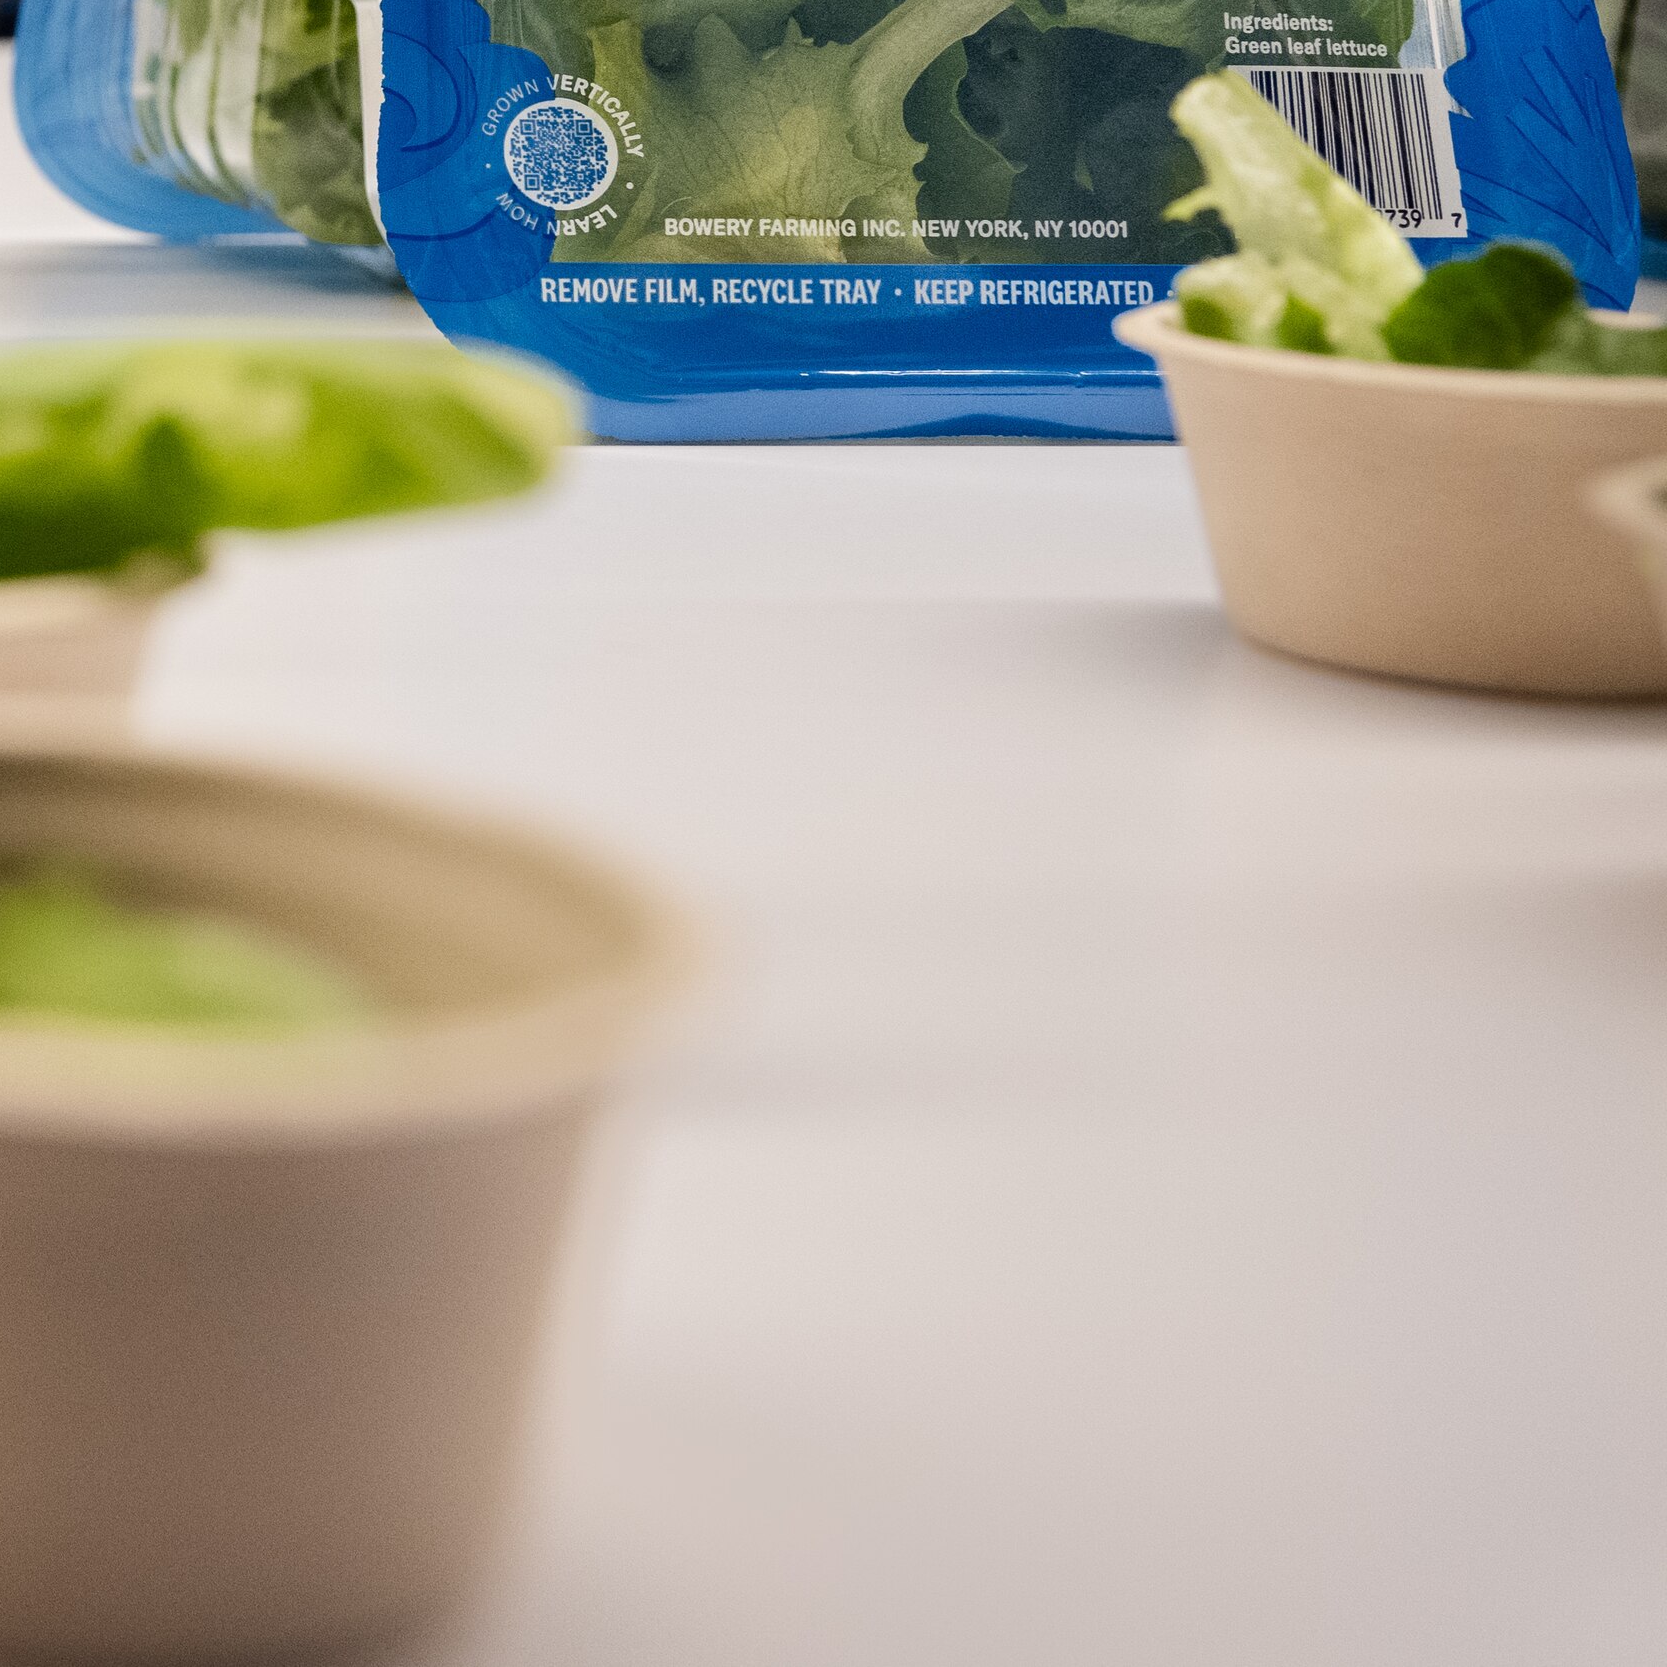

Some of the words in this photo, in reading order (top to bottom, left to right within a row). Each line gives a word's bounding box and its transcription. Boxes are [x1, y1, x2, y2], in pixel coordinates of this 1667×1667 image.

[1223, 11, 1333, 33] Ingredients:
[1225, 36, 1282, 55] Green
[1287, 36, 1322, 55] leaf
[1326, 38, 1388, 57] lettuce
[481, 78, 540, 137] GROWN
[546, 73, 644, 158] VERTICALLY
[495, 192, 539, 231] HOW
[546, 204, 617, 236] LEARN
[1375, 209, 1422, 228] 739
[1451, 213, 1462, 228] 7
[664, 217, 753, 236] BOWERY
[759, 218, 856, 237] FARMING
[863, 218, 905, 237] INC.
[912, 219, 959, 238] NEW
[965, 219, 1028, 240] YORK,
[1035, 220, 1063, 238] NY
[1069, 220, 1128, 238] 10001
[540, 277, 638, 303] REMOVE
[645, 278, 705, 307] FILM,
[713, 278, 814, 304] RECYCLE
[819, 279, 882, 304] TRAY
[914, 279, 974, 305] KEEP
[980, 279, 1154, 305] REFRIGERATED
